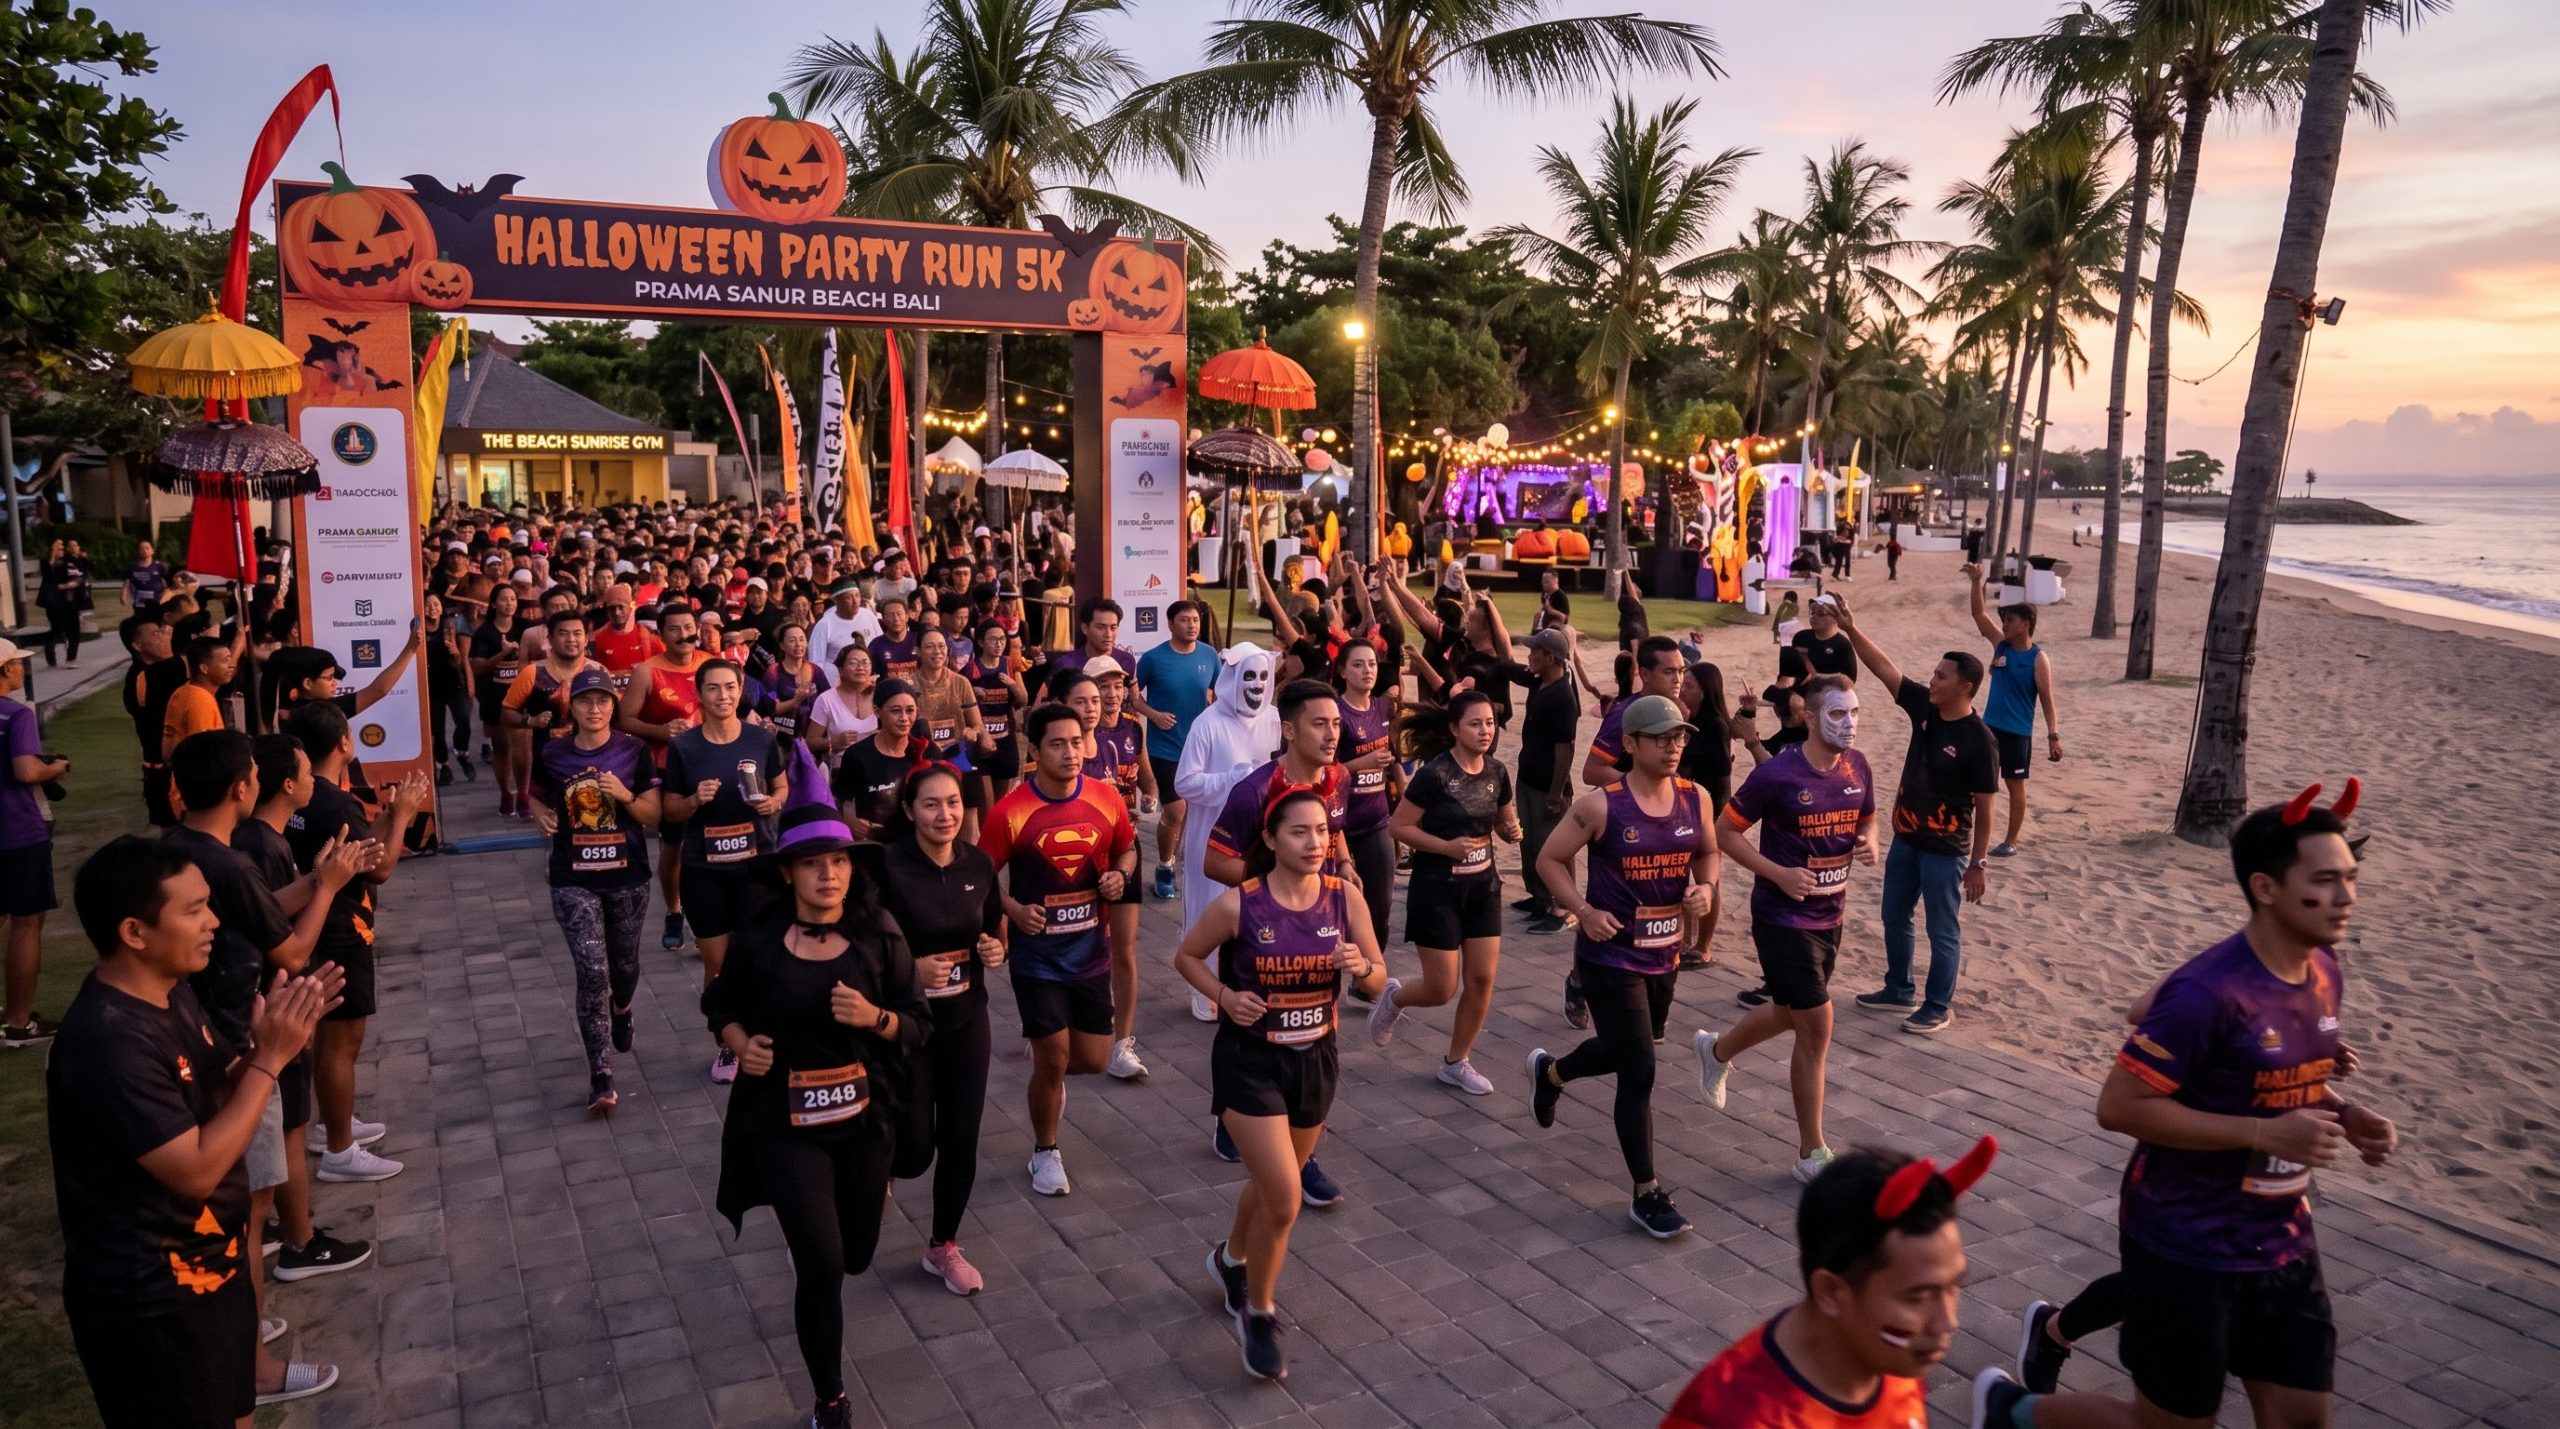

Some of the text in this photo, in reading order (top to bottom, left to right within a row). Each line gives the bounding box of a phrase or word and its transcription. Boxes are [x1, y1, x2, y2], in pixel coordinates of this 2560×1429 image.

[494, 214, 1067, 293] HALLOWEEN PARTY RUN 5K
[636, 281, 941, 311] PRAMA SANUR BEACH BALI
[482, 433, 664, 450] THE BEACH SUNRISE GYM
[318, 528, 355, 536] PRAMA
[1798, 809, 1860, 826] HALLOWEEN
[1622, 852, 1691, 869] HALLOWEEN
[1625, 868, 1660, 881] PARTY
[1057, 904, 1091, 922] 9027
[1256, 955, 1334, 971] HALLOWEE
[1259, 971, 1335, 985] PARTY RUN
[1280, 1007, 1323, 1027] 1856
[804, 1084, 856, 1108] 2848
